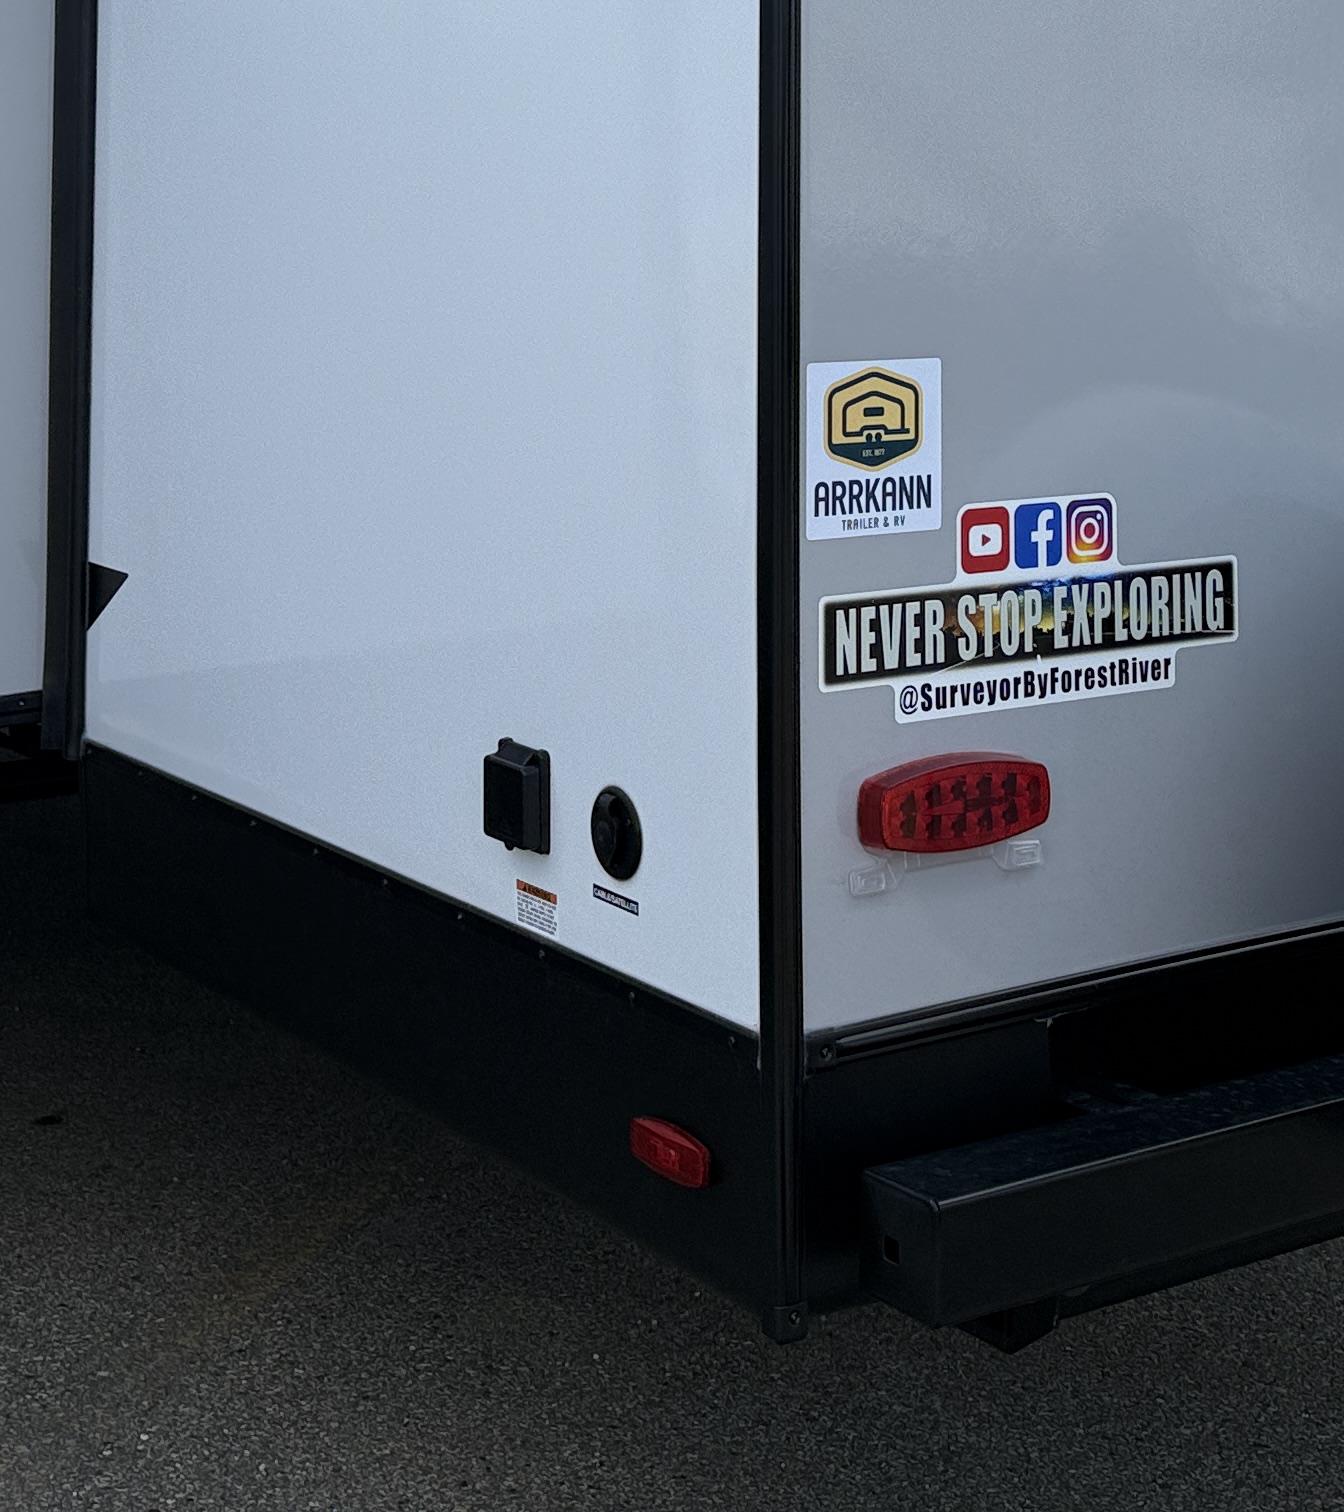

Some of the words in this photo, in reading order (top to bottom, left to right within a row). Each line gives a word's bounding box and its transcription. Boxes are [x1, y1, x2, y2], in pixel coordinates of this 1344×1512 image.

[814, 474, 932, 517] ARRKANN
[841, 517, 879, 531] TRAILER
[882, 516, 890, 528] &
[893, 515, 906, 527] RV
[835, 599, 946, 676] NEVER
[957, 589, 1042, 661] STOP
[1053, 569, 1225, 649] EXPLORING
[899, 656, 1172, 715] @SurveyorByForestRiver
